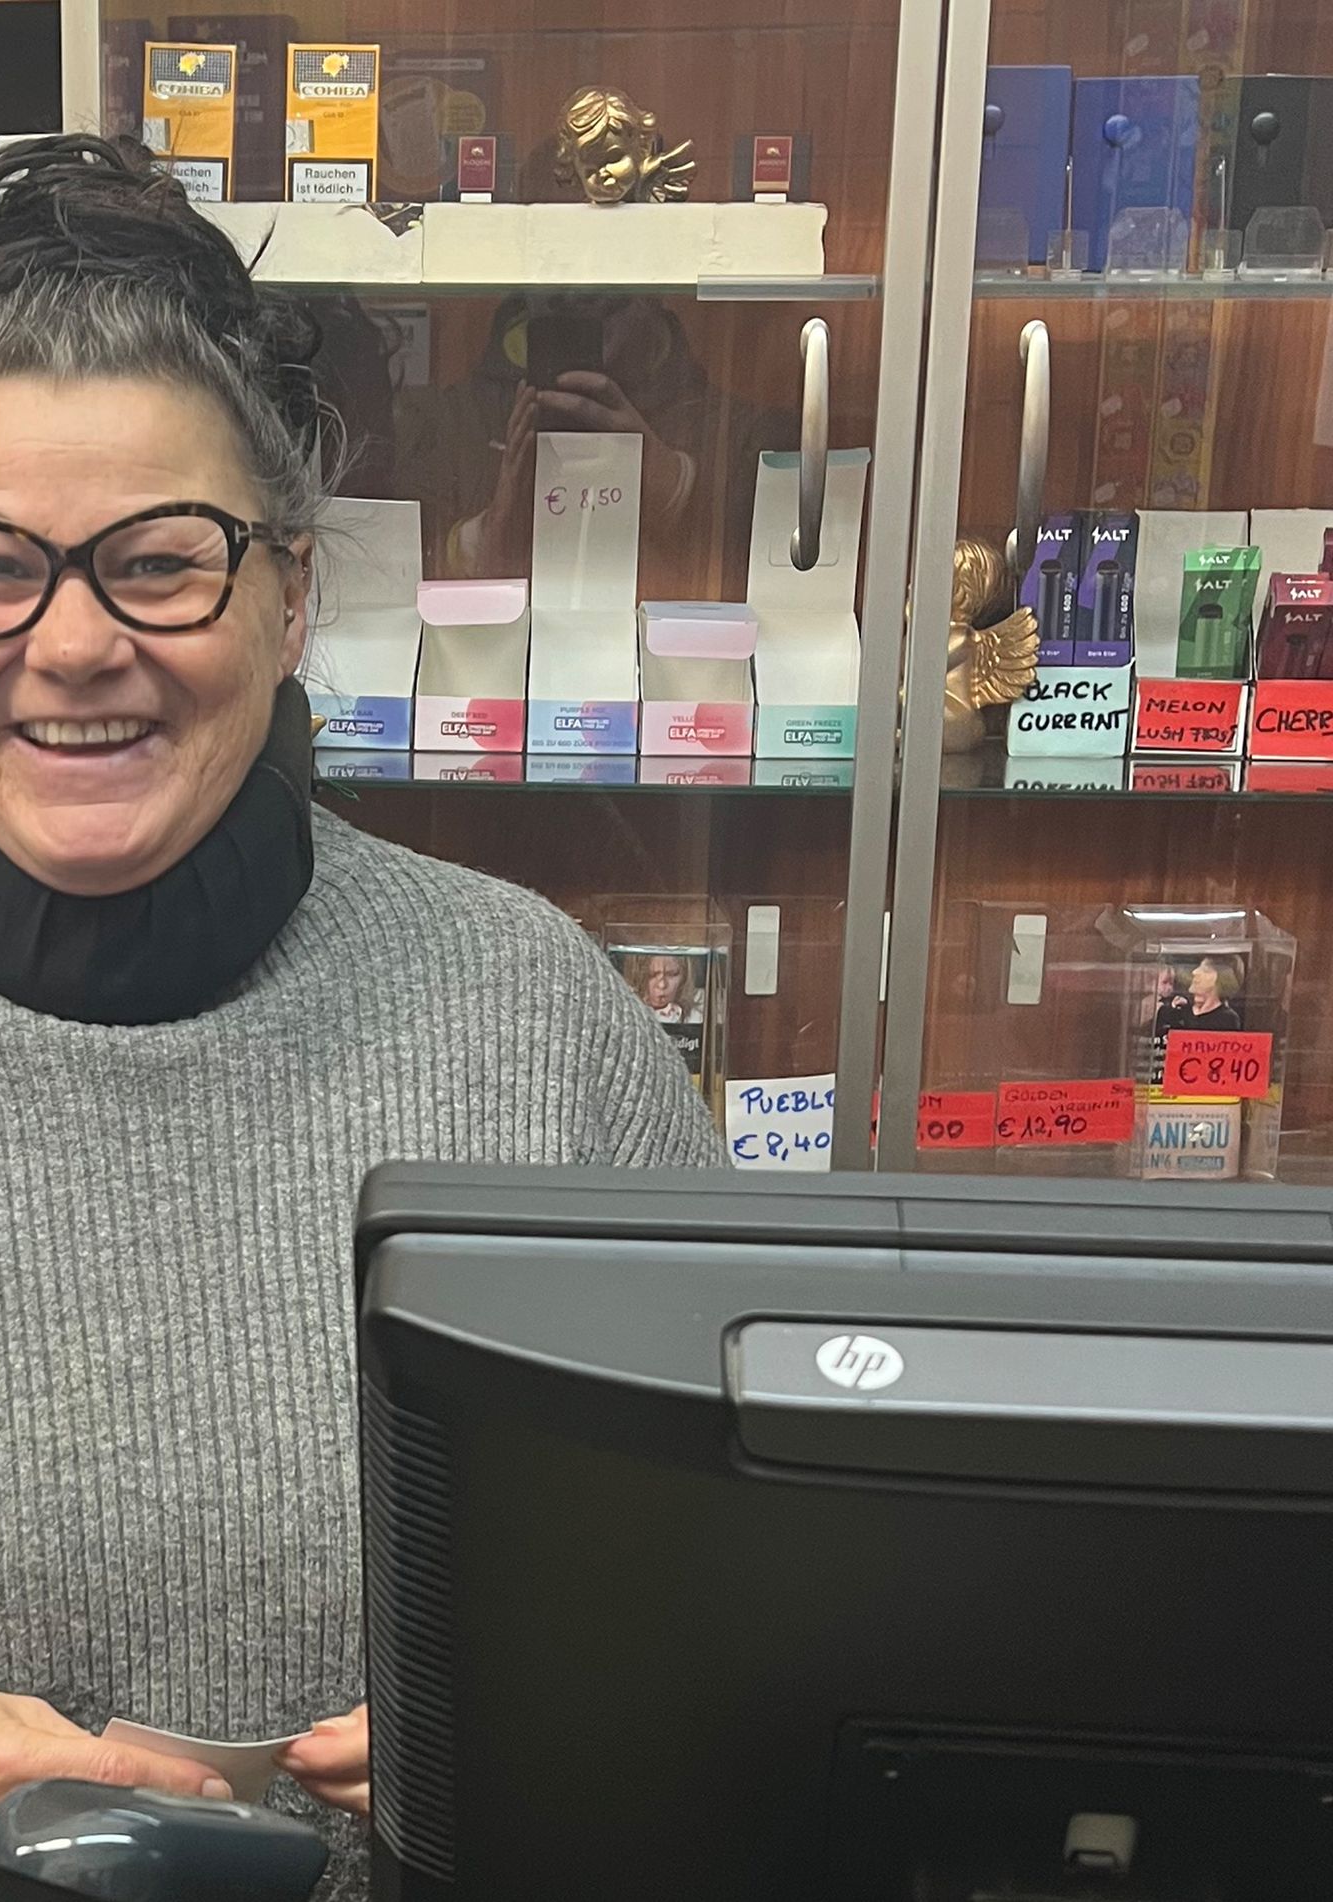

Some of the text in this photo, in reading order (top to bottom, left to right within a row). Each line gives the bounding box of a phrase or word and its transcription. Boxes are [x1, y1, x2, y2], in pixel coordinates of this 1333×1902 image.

[158, 83, 222, 96] COHIBA
[301, 85, 366, 97] COHIBA
[305, 167, 356, 179] Rauchen
[296, 182, 354, 194] ist tödlich
[544, 486, 622, 515] € 8,50
[1092, 526, 1130, 544] SALT
[1199, 554, 1231, 566] SALT
[1290, 587, 1323, 601] SALT
[1146, 698, 1226, 714] MELON
[329, 720, 356, 733] ELFA
[442, 722, 468, 736] ELFA
[555, 718, 582, 730] ELFA
[669, 726, 697, 739] ELFA
[786, 731, 813, 743] ELFA
[1136, 726, 1185, 742] LUSH
[1182, 1040, 1254, 1054] MANITOU
[1179, 1058, 1200, 1084] €
[1207, 1057, 1260, 1086] 8,40
[1020, 1114, 1088, 1138] 12,90
[733, 1131, 831, 1161] € 8,40
